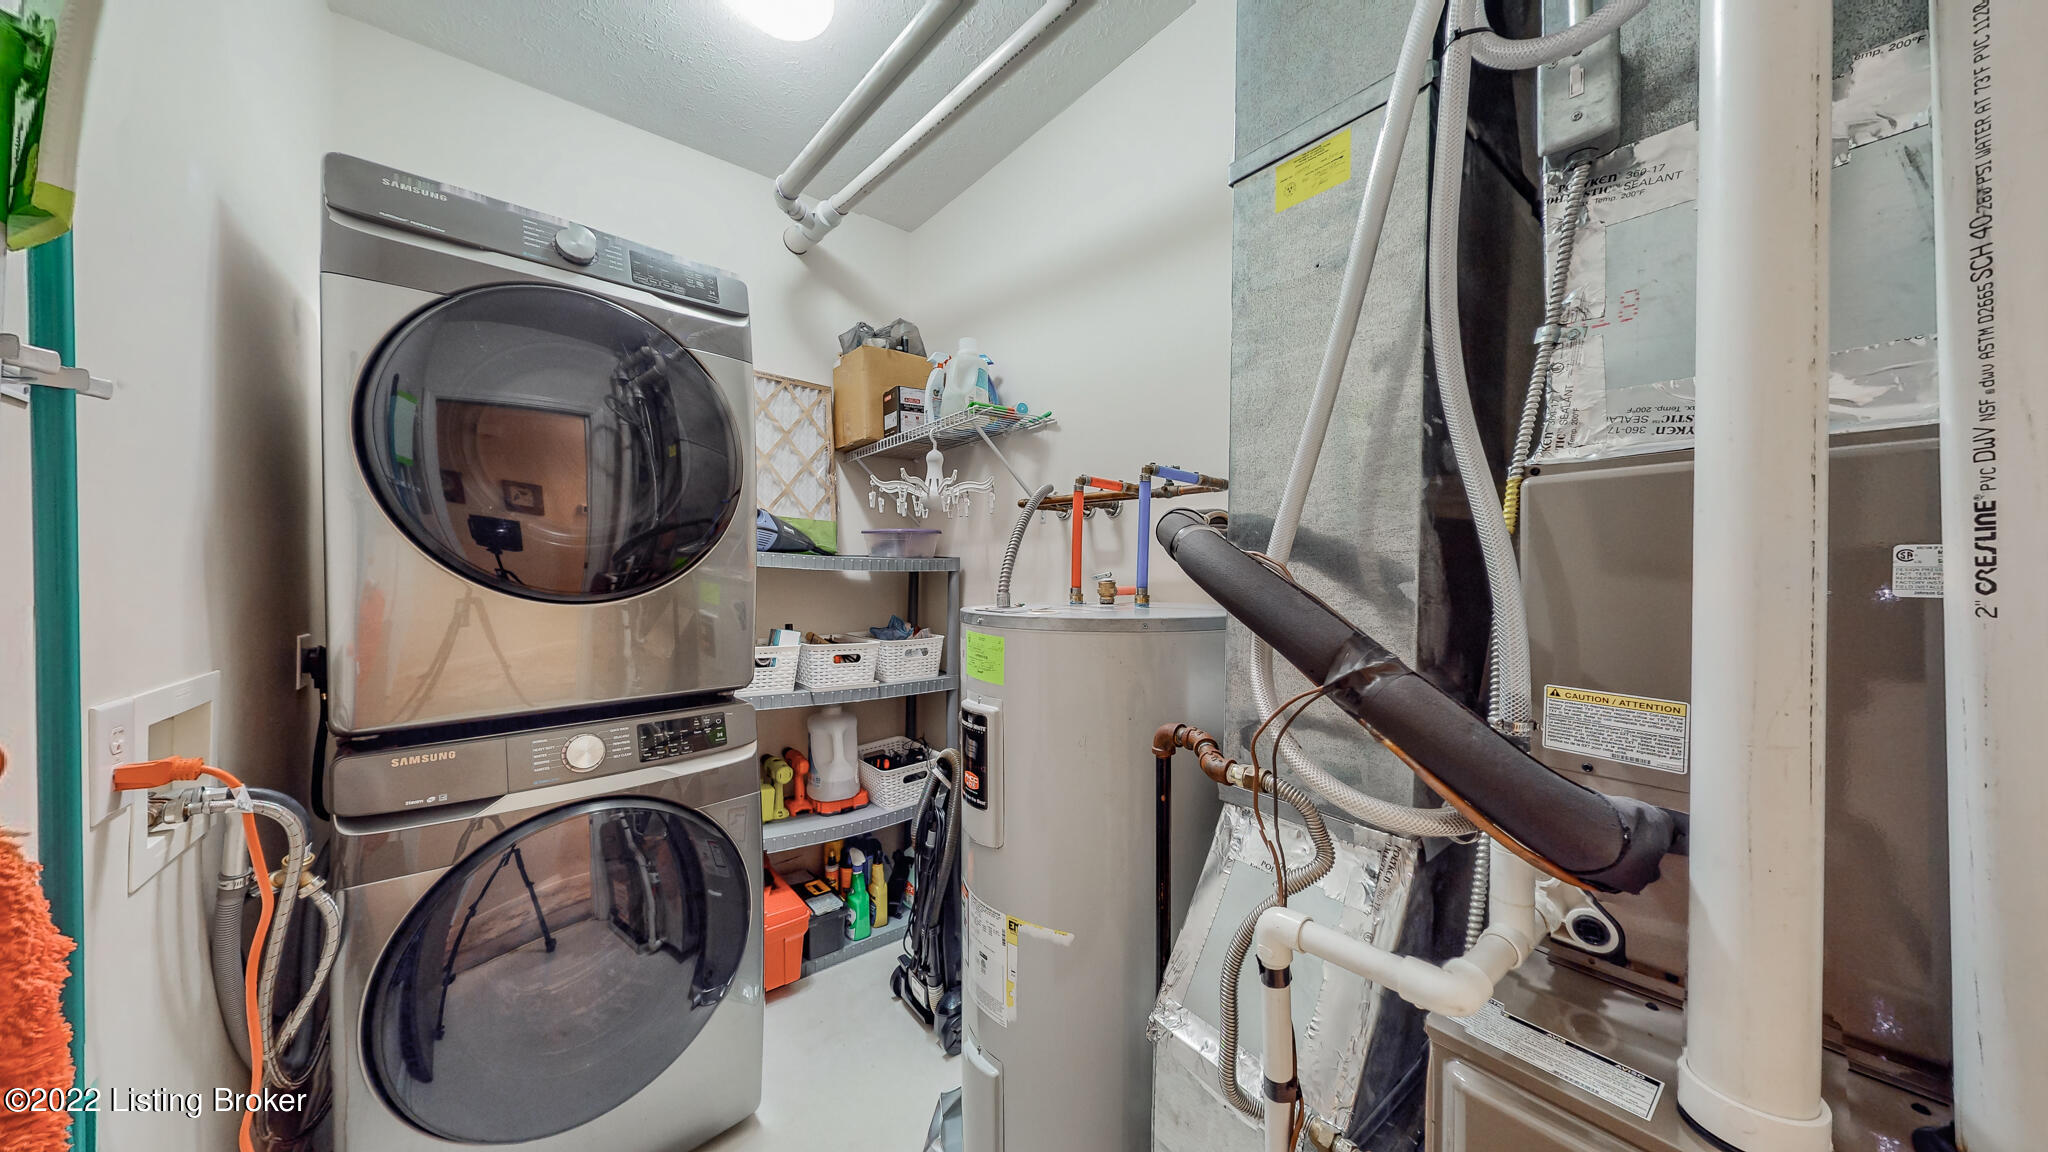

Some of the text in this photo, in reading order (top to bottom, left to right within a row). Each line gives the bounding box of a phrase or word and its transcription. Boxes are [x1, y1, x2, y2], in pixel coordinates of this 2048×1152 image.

[1973, 34, 1991, 64] PVC
[1974, 97, 1992, 115] AT
[1974, 115, 1992, 161] WATER
[382, 177, 448, 202] SAMSUNG
[1622, 170, 1684, 192] SEALANT
[1969, 241, 1994, 283] SCH
[1976, 281, 1995, 325] D2665
[1977, 326, 1995, 361] ASTM
[1558, 384, 1575, 426] SEALANT
[1978, 399, 1997, 422] NSF
[1972, 427, 1997, 463] DWV
[1979, 466, 1997, 492] PVC
[1564, 692, 1609, 705] CAUTION
[1618, 699, 1681, 715] ATTENTION
[391, 750, 456, 767] SAMSUNG
